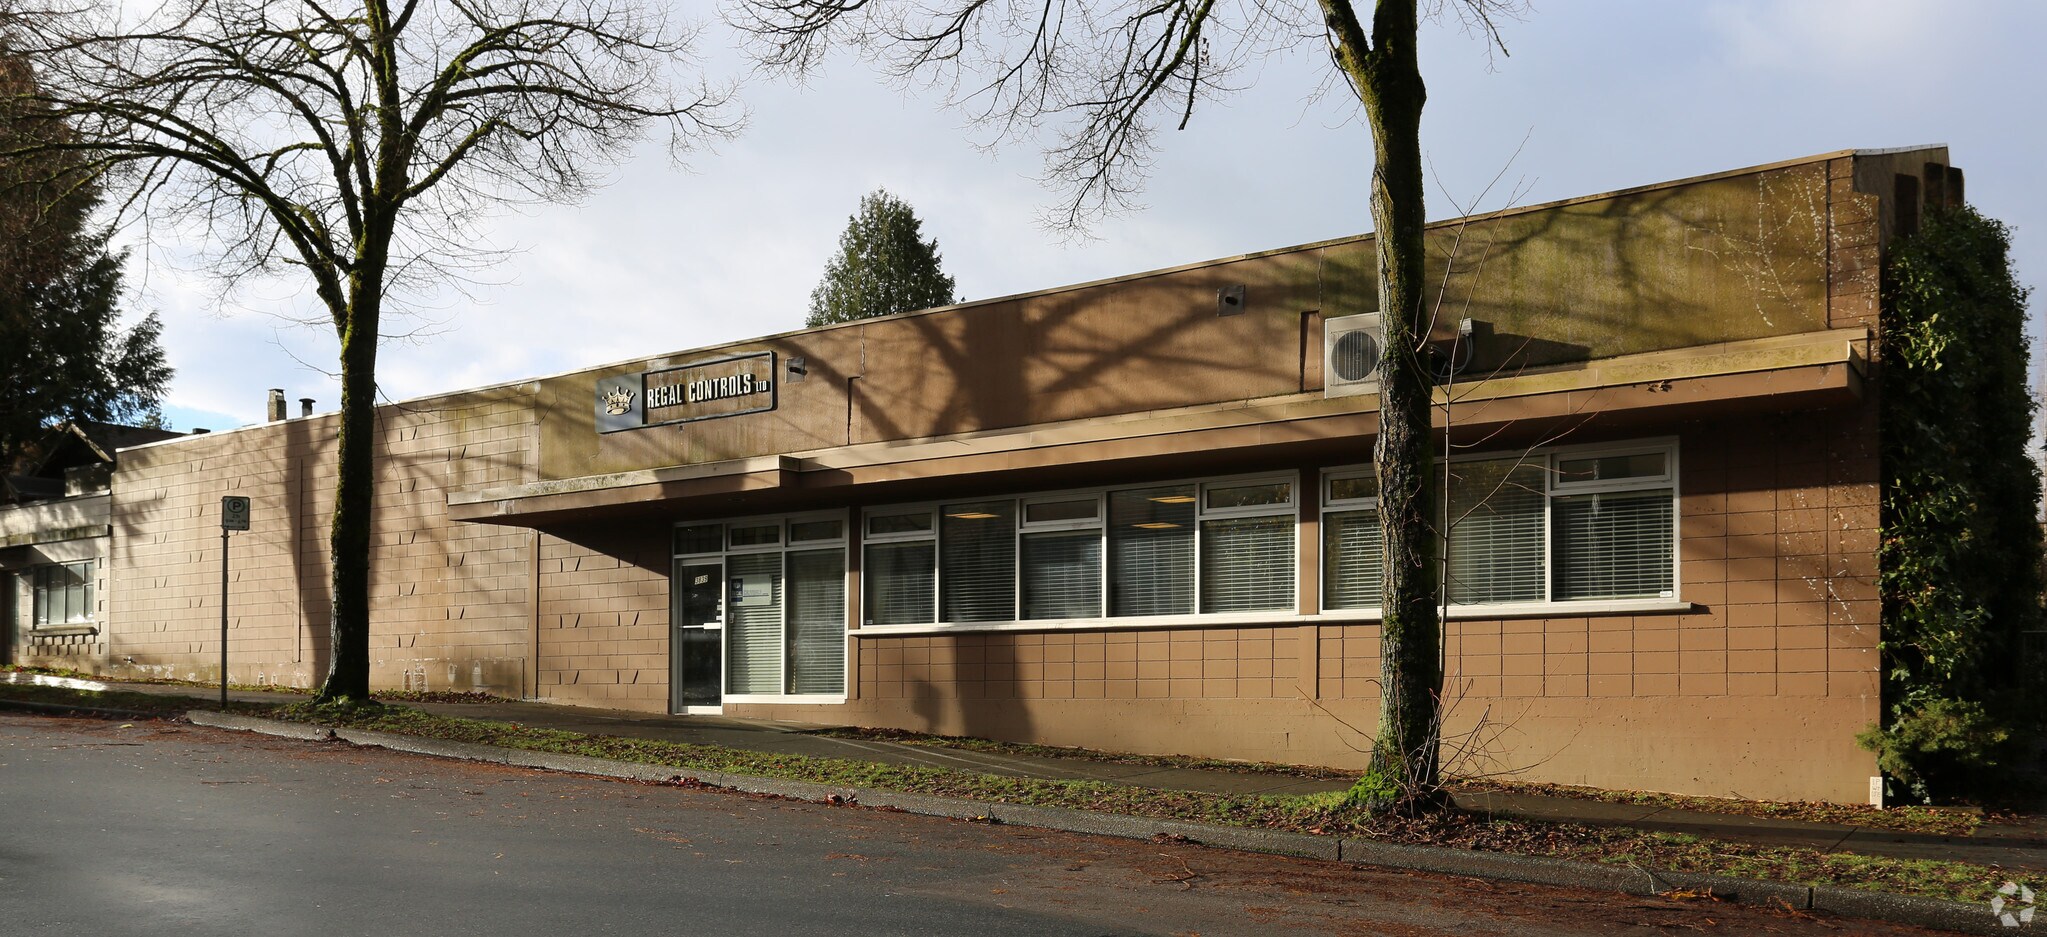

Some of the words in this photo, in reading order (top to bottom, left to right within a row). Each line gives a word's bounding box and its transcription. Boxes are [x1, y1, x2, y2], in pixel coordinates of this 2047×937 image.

[647, 384, 682, 408] REGAL
[688, 374, 751, 402] CONTROLS
[756, 380, 768, 392] LTD
[233, 502, 241, 510] P
